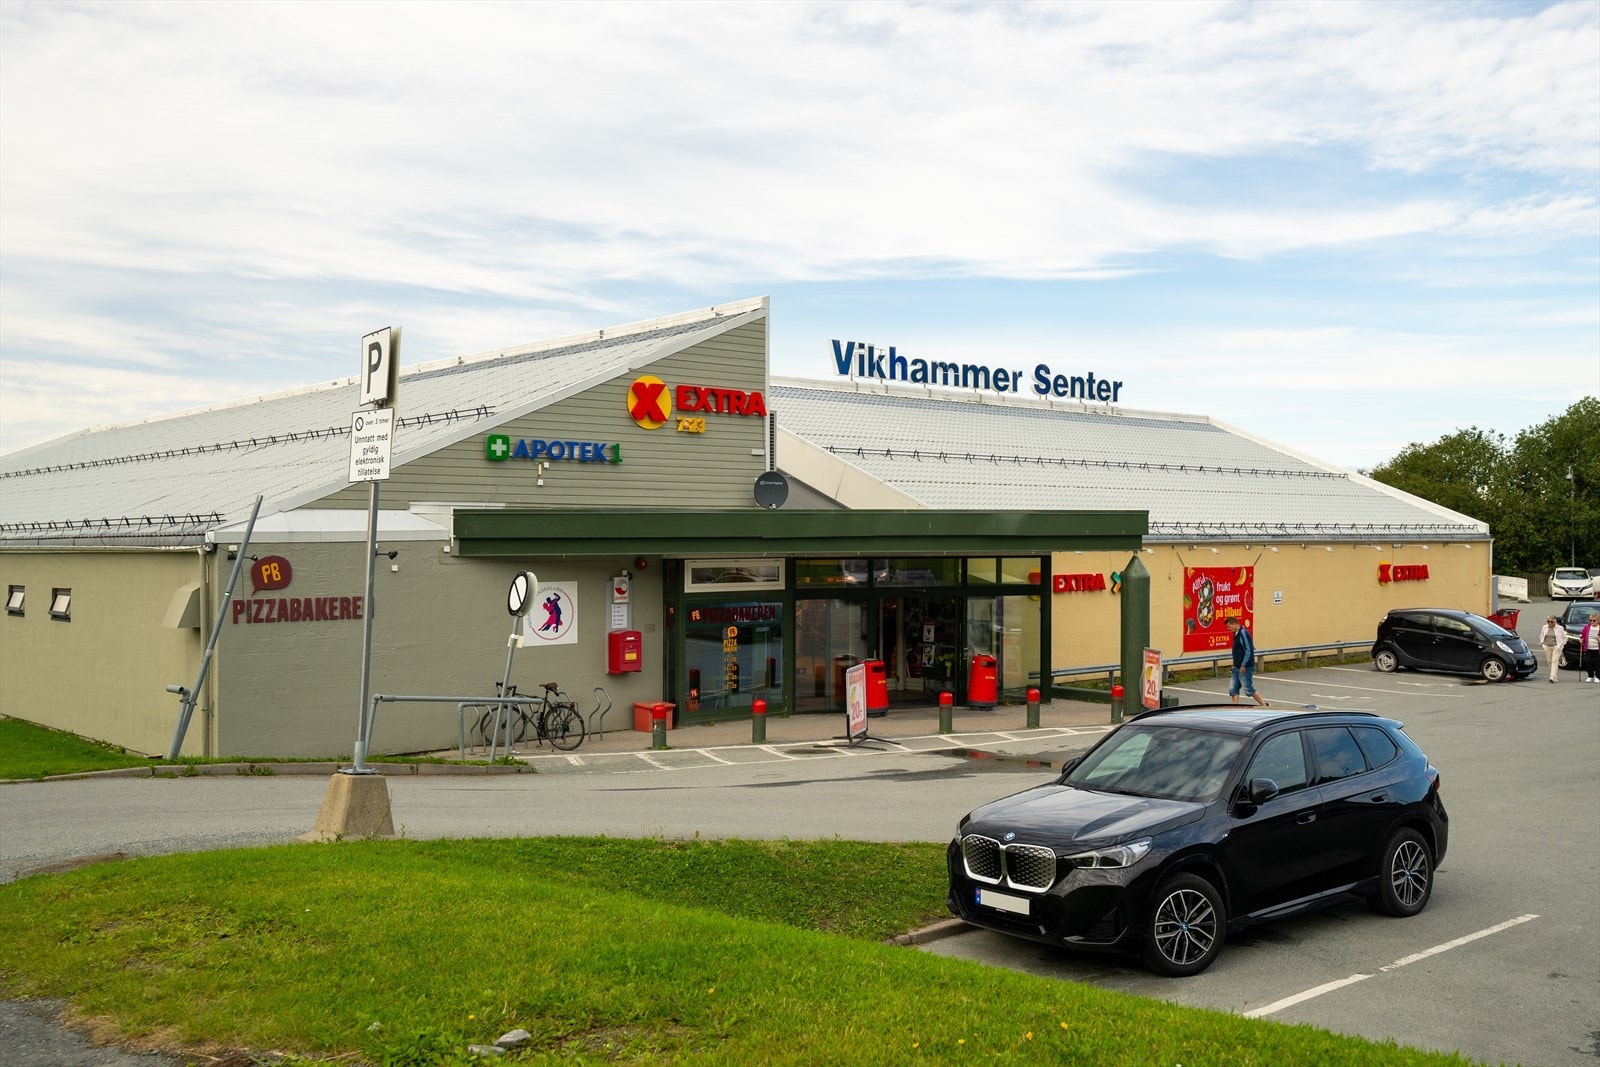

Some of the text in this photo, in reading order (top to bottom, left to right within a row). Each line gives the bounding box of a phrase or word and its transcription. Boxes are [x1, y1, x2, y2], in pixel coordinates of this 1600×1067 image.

[367, 341, 382, 394] P
[829, 339, 1123, 402] Vikhammer Senter
[676, 385, 767, 416] EXTRA
[676, 416, 706, 433] 7-23
[355, 433, 389, 444] Unntatt med
[362, 445, 379, 456] gyldig
[513, 438, 607, 463] APOTEK
[355, 456, 384, 466] elektronisk
[357, 467, 381, 477] tillatelse
[261, 562, 282, 584] PB
[1393, 564, 1429, 582] EXTRA
[1053, 573, 1107, 593] EXTRA
[1216, 581, 1231, 592] frukt
[1215, 593, 1241, 606] og grønt
[232, 595, 375, 625] PIZZABAKERE
[703, 605, 776, 623] PIZZABAKEREN
[1215, 606, 1243, 620] på tilbud
[723, 639, 738, 647] PIZZA
